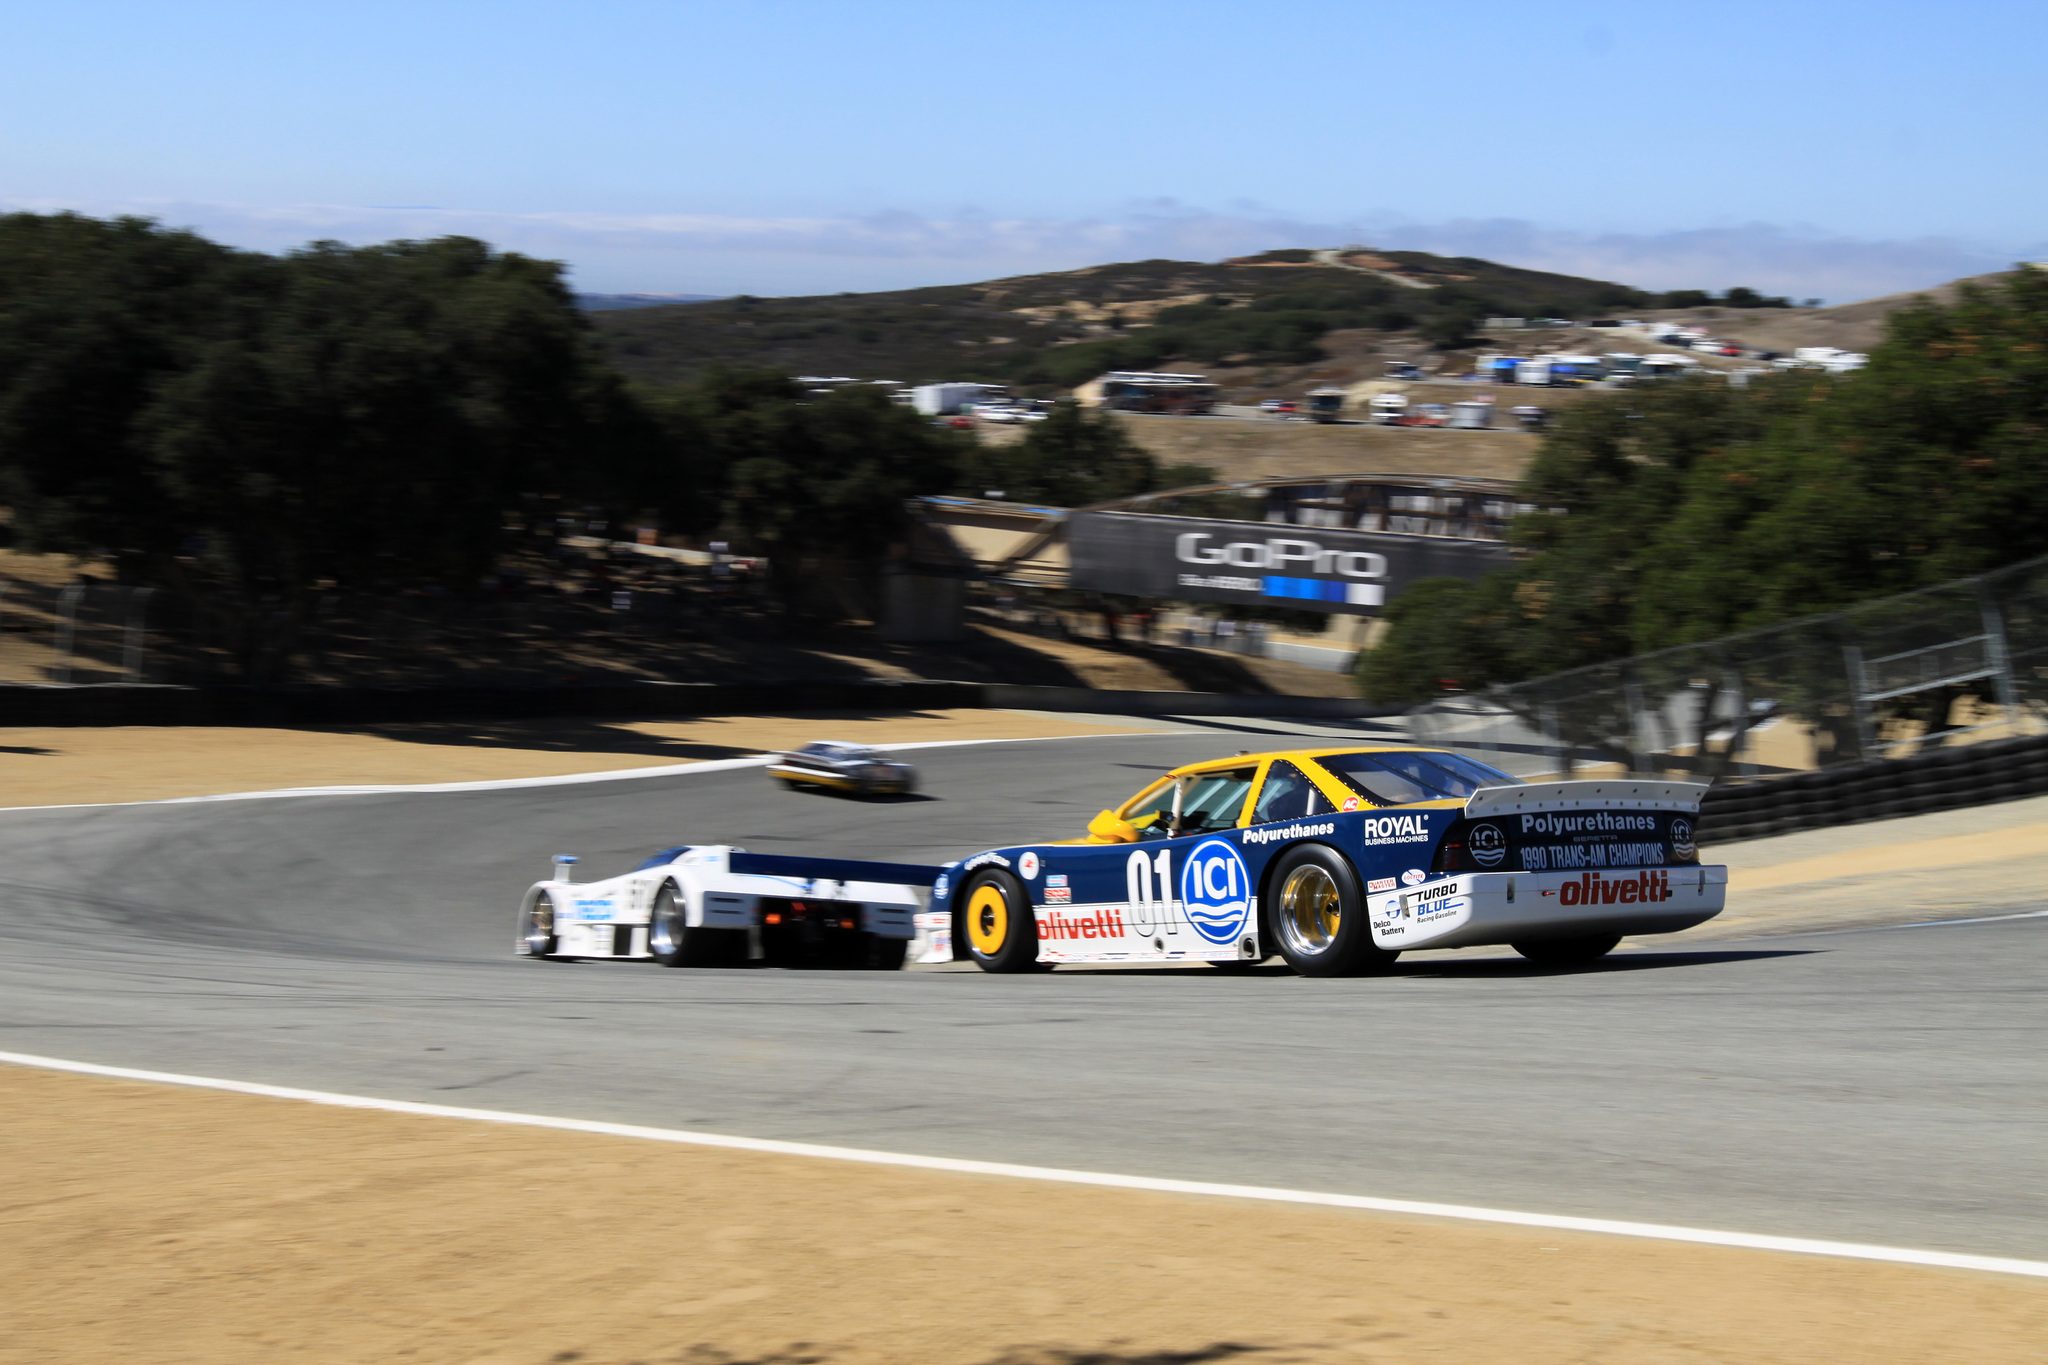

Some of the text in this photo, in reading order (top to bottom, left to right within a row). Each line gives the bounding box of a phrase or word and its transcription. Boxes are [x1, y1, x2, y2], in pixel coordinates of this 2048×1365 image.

[1175, 533, 1388, 578] GoPro
[1343, 799, 1358, 810] AC
[1364, 815, 1429, 839] ROYAL
[1521, 812, 1656, 836] Polyurethanes
[1242, 822, 1335, 845] Polyurethanes
[1365, 834, 1429, 846] BUSINESS MACHINES
[1475, 830, 1499, 847] ICI
[1573, 834, 1618, 843] BERETTA
[1520, 842, 1665, 870] 1990 TRANS-AM CHAMPIONS
[1192, 856, 1238, 900] ICI
[1368, 878, 1394, 888] QUARTER
[1373, 882, 1396, 890] MASTER
[1403, 873, 1424, 881] LOCTITE
[1126, 849, 1178, 937] 01
[1407, 883, 1458, 902] TURBO
[1560, 870, 1668, 906] olivetti
[1417, 898, 1464, 916] BLUE
[1036, 909, 1125, 940] olivetti
[1373, 920, 1391, 929] Delco
[1416, 910, 1457, 924] Racing Gasoline
[1381, 926, 1405, 936] Battery
